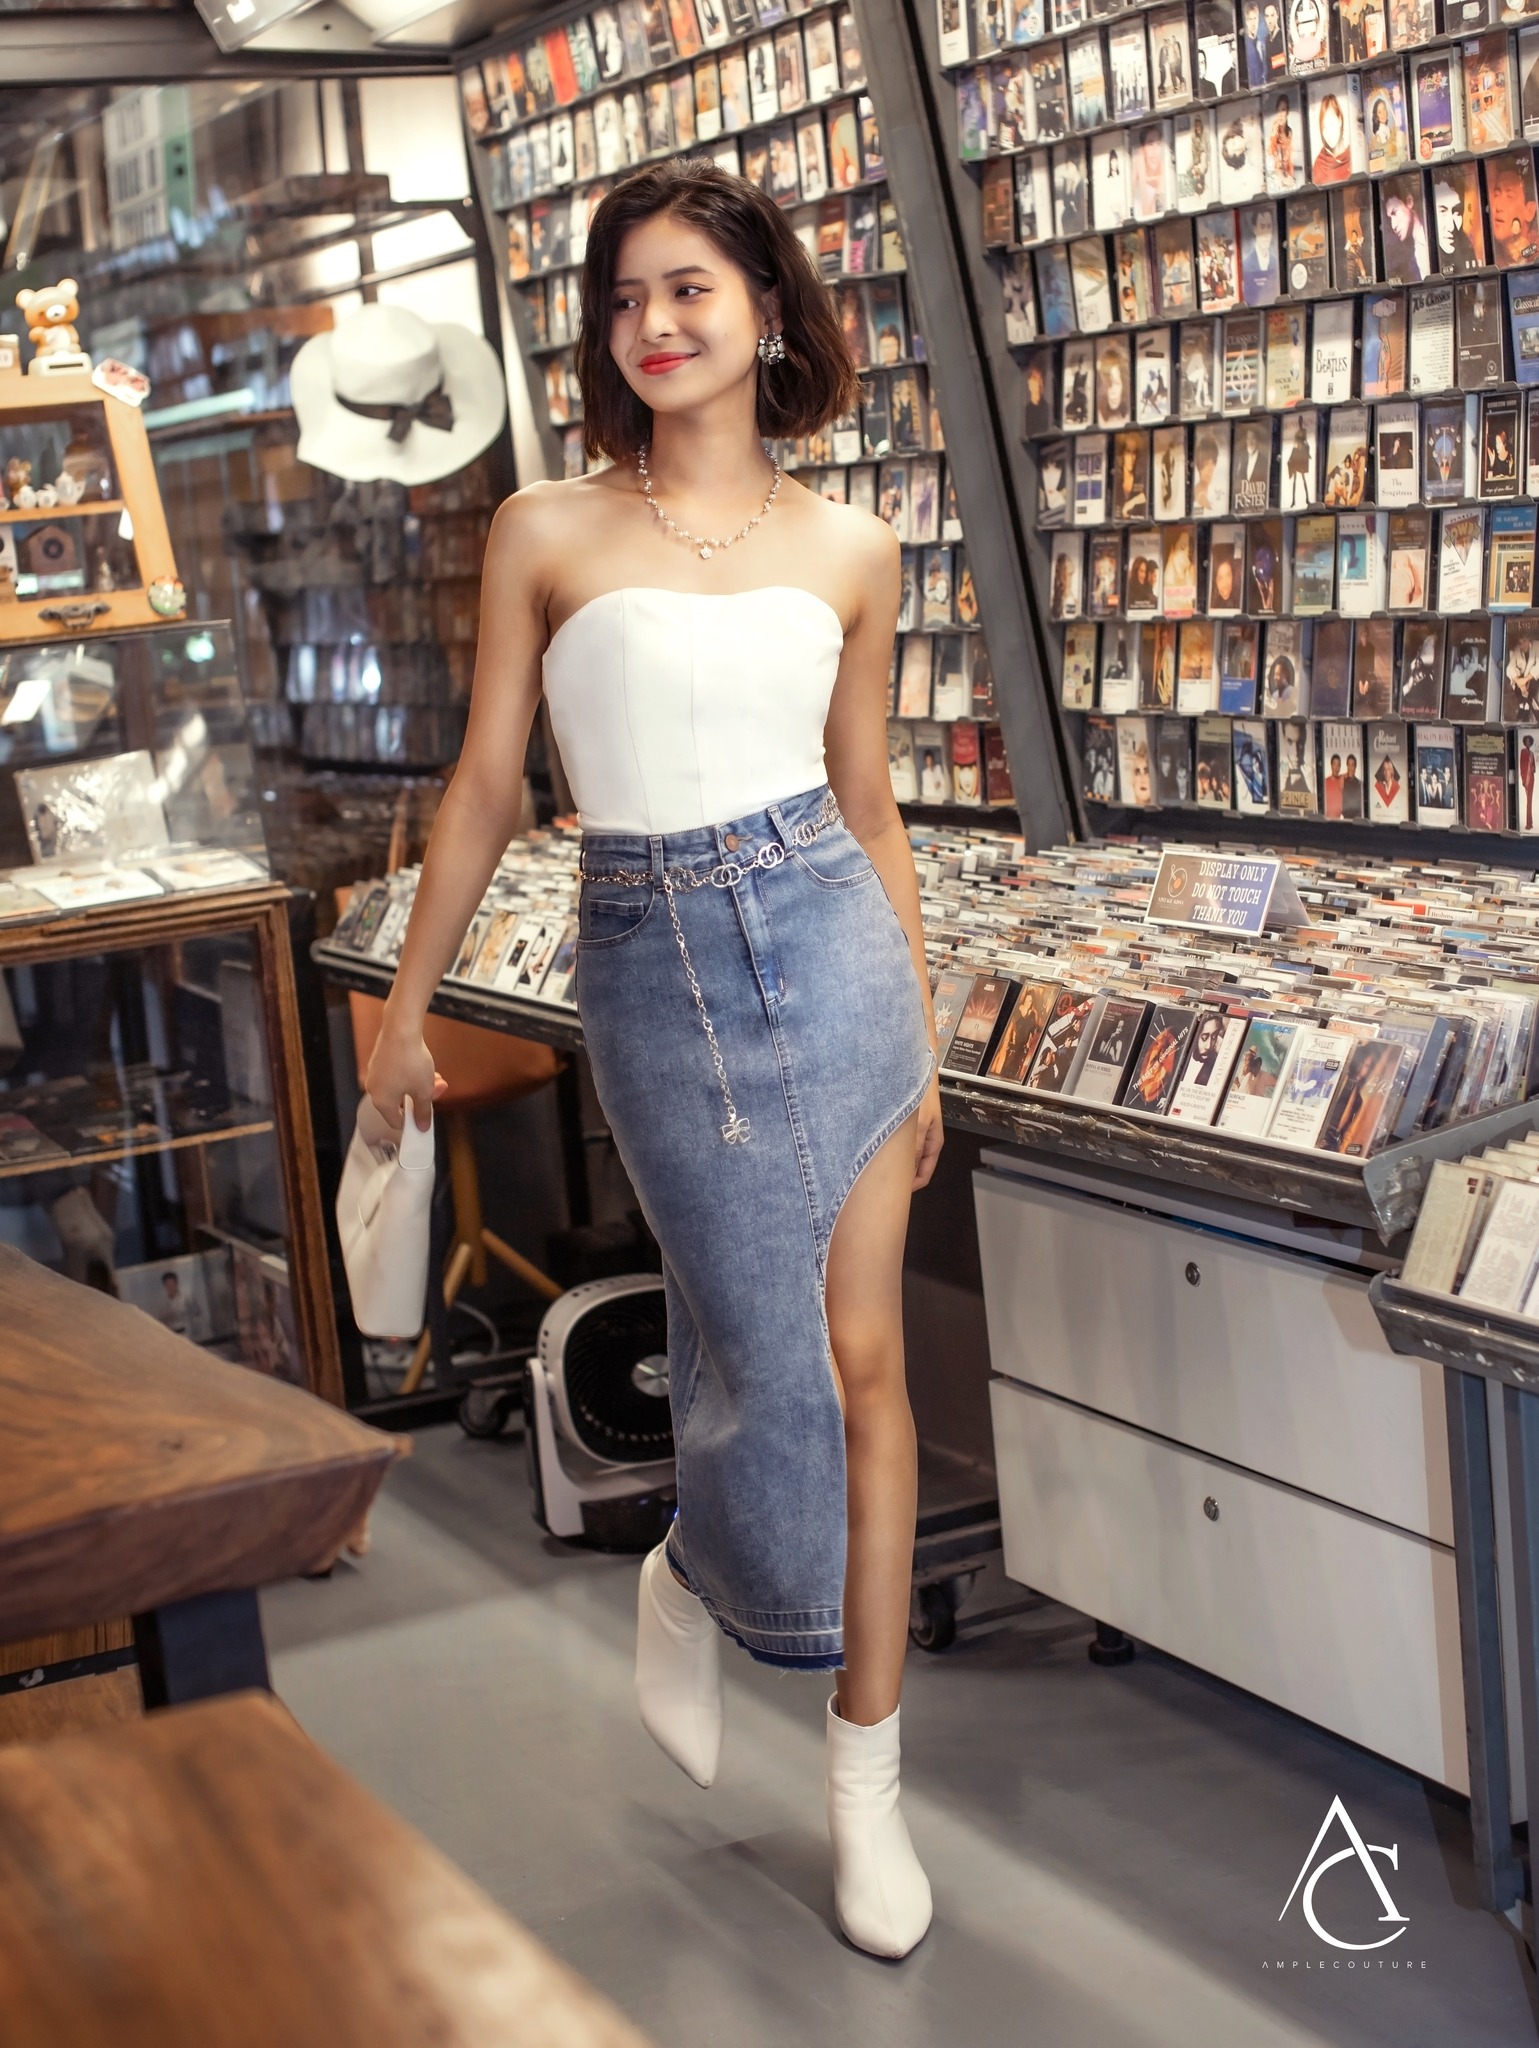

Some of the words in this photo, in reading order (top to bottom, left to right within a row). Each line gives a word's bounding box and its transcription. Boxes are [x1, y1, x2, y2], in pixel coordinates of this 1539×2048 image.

[1316, 349, 1348, 378] BEATLES
[1241, 479, 1266, 495] DAVID
[1235, 493, 1266, 509] FOSTER
[1281, 793, 1309, 806] PRINCE
[1199, 861, 1239, 879] DISPLAY
[1240, 864, 1267, 882] ONLY
[1191, 883, 1205, 898] DO
[1206, 885, 1229, 901] NOT
[1229, 886, 1262, 905] TOUCH
[1192, 905, 1225, 923] THANK
[1226, 909, 1248, 926] YOU
[1132, 1079, 1142, 1090] THE
[1177, 1026, 1189, 1041] HITS
